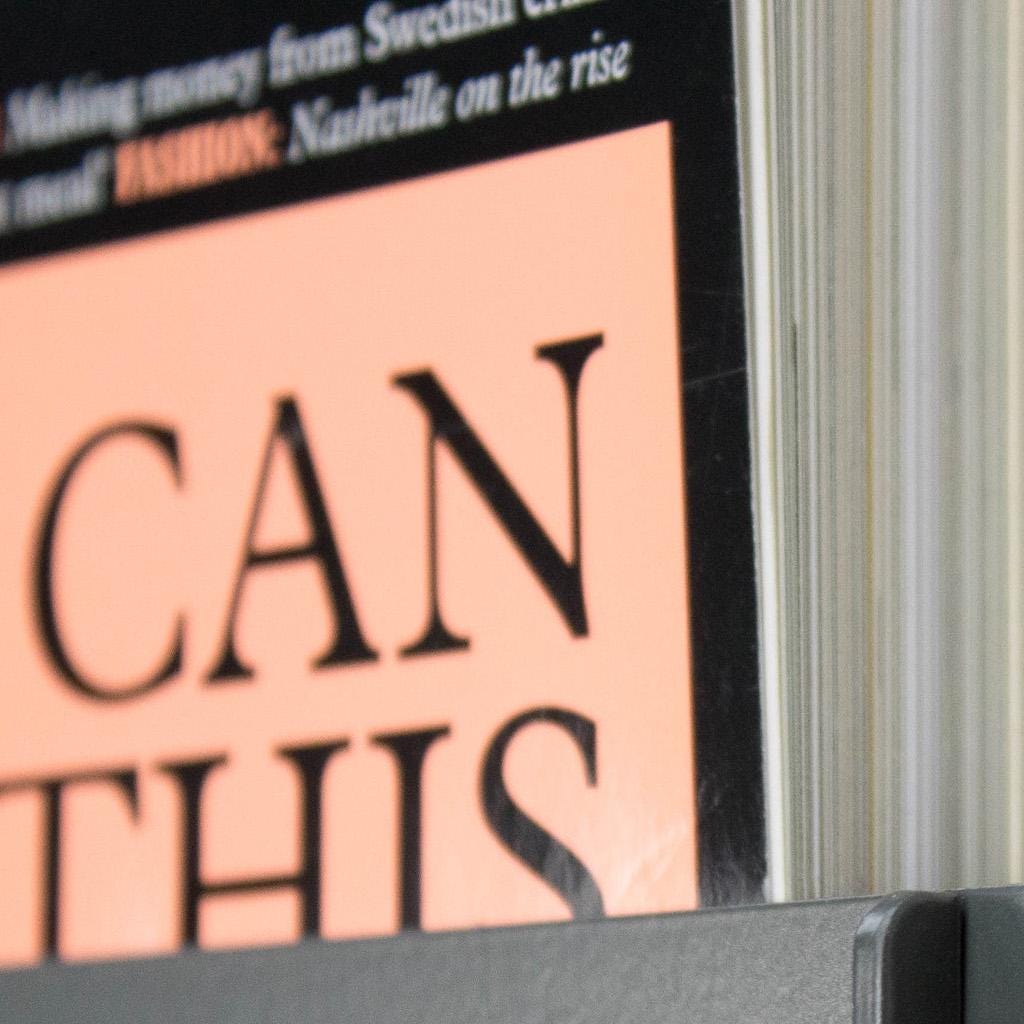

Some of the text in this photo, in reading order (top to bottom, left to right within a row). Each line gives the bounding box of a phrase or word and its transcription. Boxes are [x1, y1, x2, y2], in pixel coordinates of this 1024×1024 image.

[5, 0, 517, 149] Making money from Swedish
[287, 70, 450, 164] Nashville
[455, 73, 501, 121] on
[508, 46, 562, 108] the
[570, 29, 632, 90] rise
[27, 332, 606, 706] CAN
[0, 705, 606, 965] THIS
